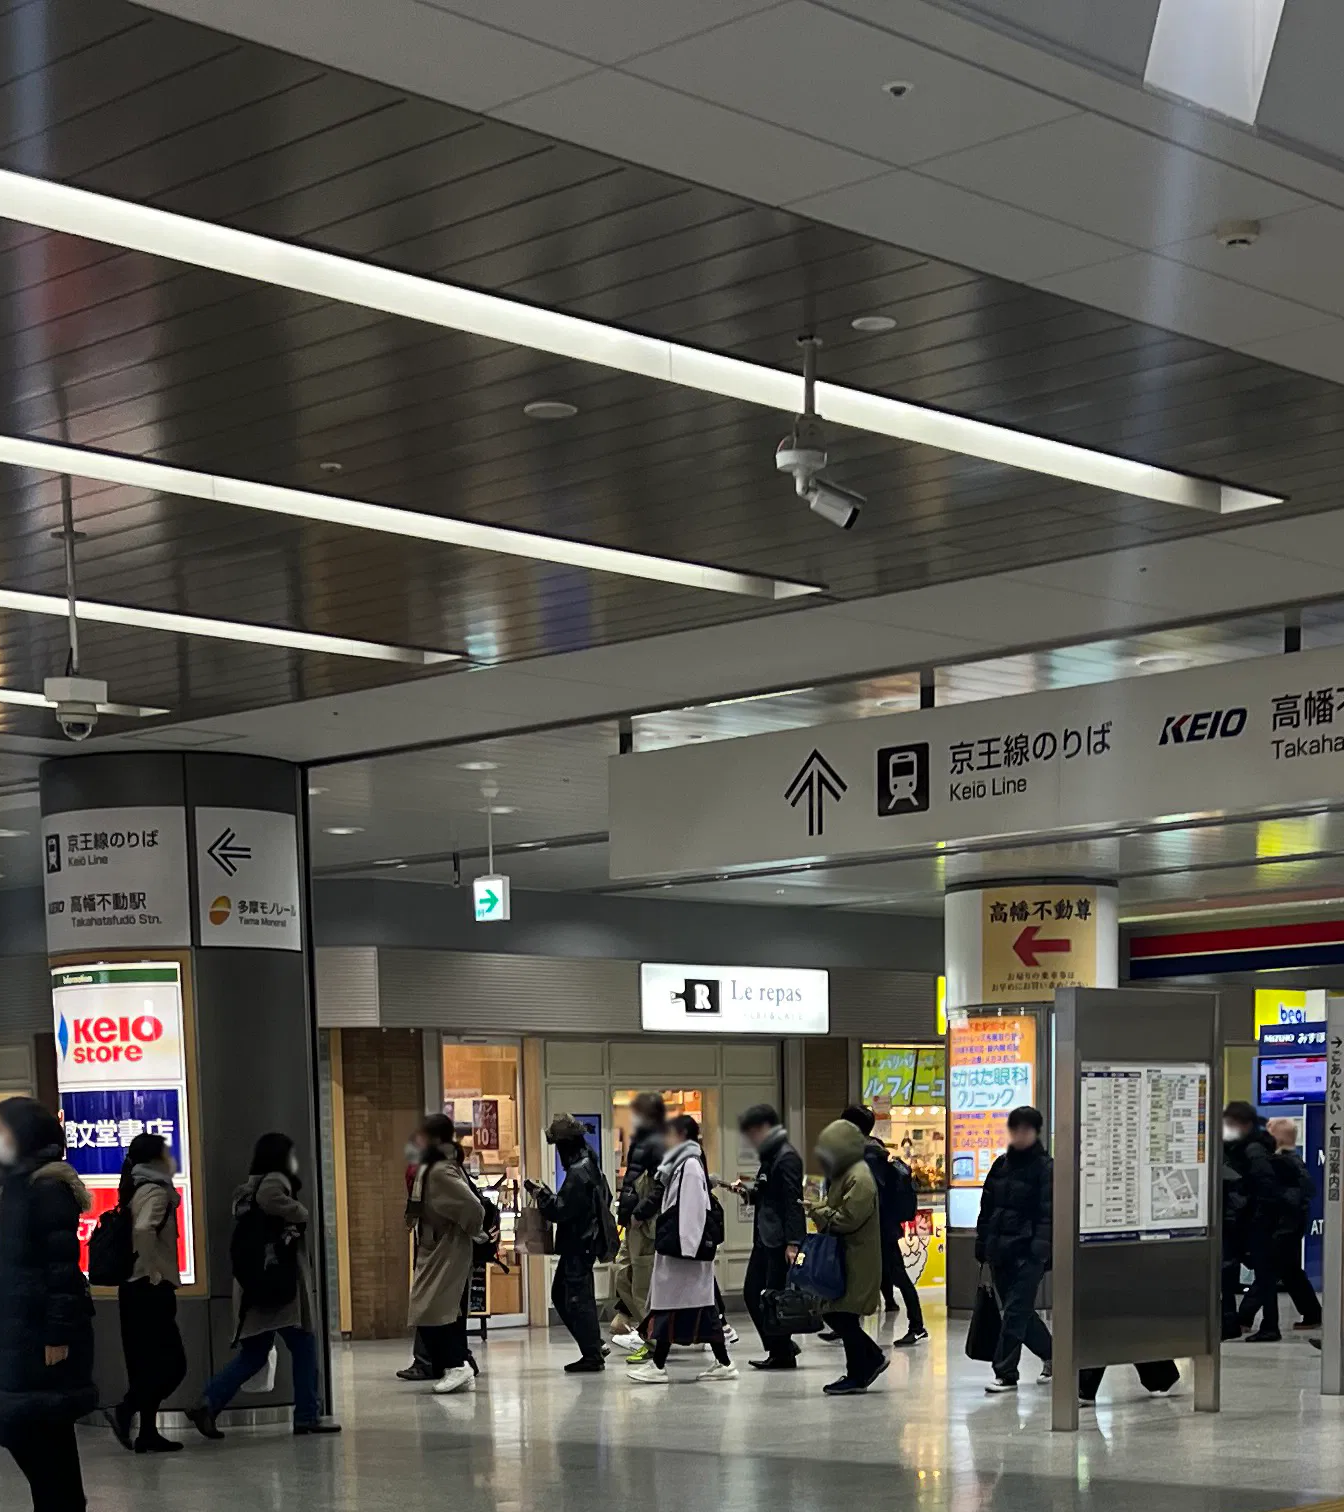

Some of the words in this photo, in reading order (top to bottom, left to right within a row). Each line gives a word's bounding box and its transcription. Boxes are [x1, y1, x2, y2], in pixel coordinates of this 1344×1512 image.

[1158, 707, 1248, 746] KEIO
[949, 720, 1112, 775] 京王線のりば
[992, 776, 1027, 796] Line
[67, 830, 159, 852] 京王線のりば
[88, 855, 108, 866] Line
[70, 892, 146, 912] 高幡不動駅
[989, 898, 1092, 923] 高幡不動尊
[731, 980, 753, 1001] Le
[759, 986, 802, 1006] repas
[1330, 1051, 1342, 1115] ごあんない
[957, 1089, 1015, 1109] クリニック
[1311, 1219, 1324, 1235] AT
